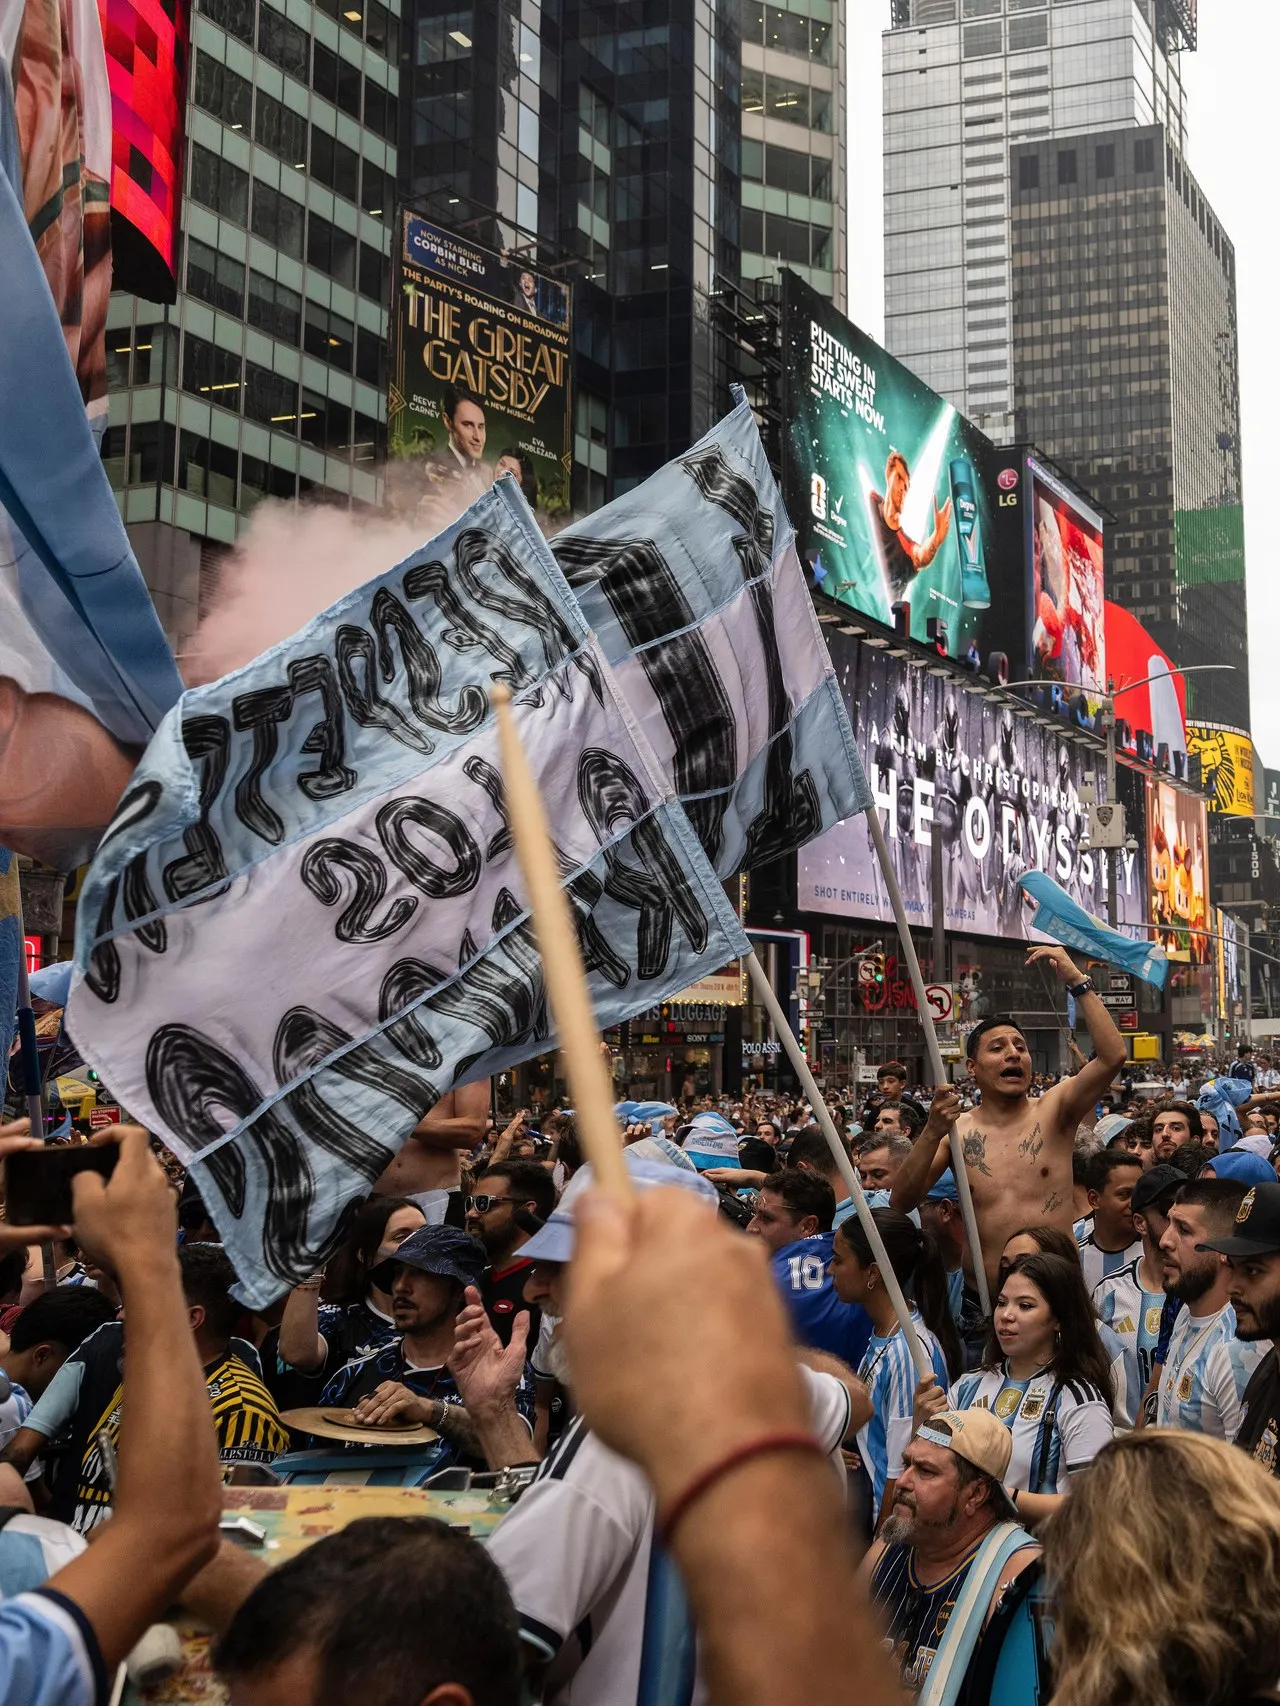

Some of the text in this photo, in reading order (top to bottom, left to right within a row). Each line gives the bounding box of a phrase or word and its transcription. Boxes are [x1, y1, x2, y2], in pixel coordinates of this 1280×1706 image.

[414, 236, 486, 275] CORBIN BLEU
[420, 229, 482, 263] NOW STARRING
[435, 256, 468, 277] AS NICK
[402, 266, 568, 345] THE PARTY'S ROARING ON BROADWAY
[407, 291, 568, 386] THE GREAT
[810, 320, 876, 386] PUTTING IN
[422, 340, 550, 414] GATSBY
[810, 341, 875, 406] THE SWEAT
[409, 401, 440, 419] CARNEY
[413, 394, 437, 409] REEVE
[491, 401, 506, 412] NEW
[507, 406, 536, 424] MUSICAL
[810, 363, 887, 435] STARTS NOW.
[518, 441, 557, 461] NOBLEZADA
[532, 437, 545, 448] EVA
[998, 494, 1017, 507] LG
[870, 721, 880, 745] A
[890, 734, 927, 761] FILM
[936, 749, 953, 770] BY
[961, 754, 1067, 810] CHRISTOPHER
[870, 763, 935, 847] HE
[1251, 843, 1259, 878] 1500
[814, 885, 837, 898] SHOT
[841, 890, 879, 906] ENTIRELY
[946, 906, 975, 921] CAMERAS
[670, 1004, 727, 1022] LUGGAGE
[686, 1034, 708, 1042] SONY
[742, 1043, 760, 1054] POLO
[788, 1255, 825, 1290] 10
